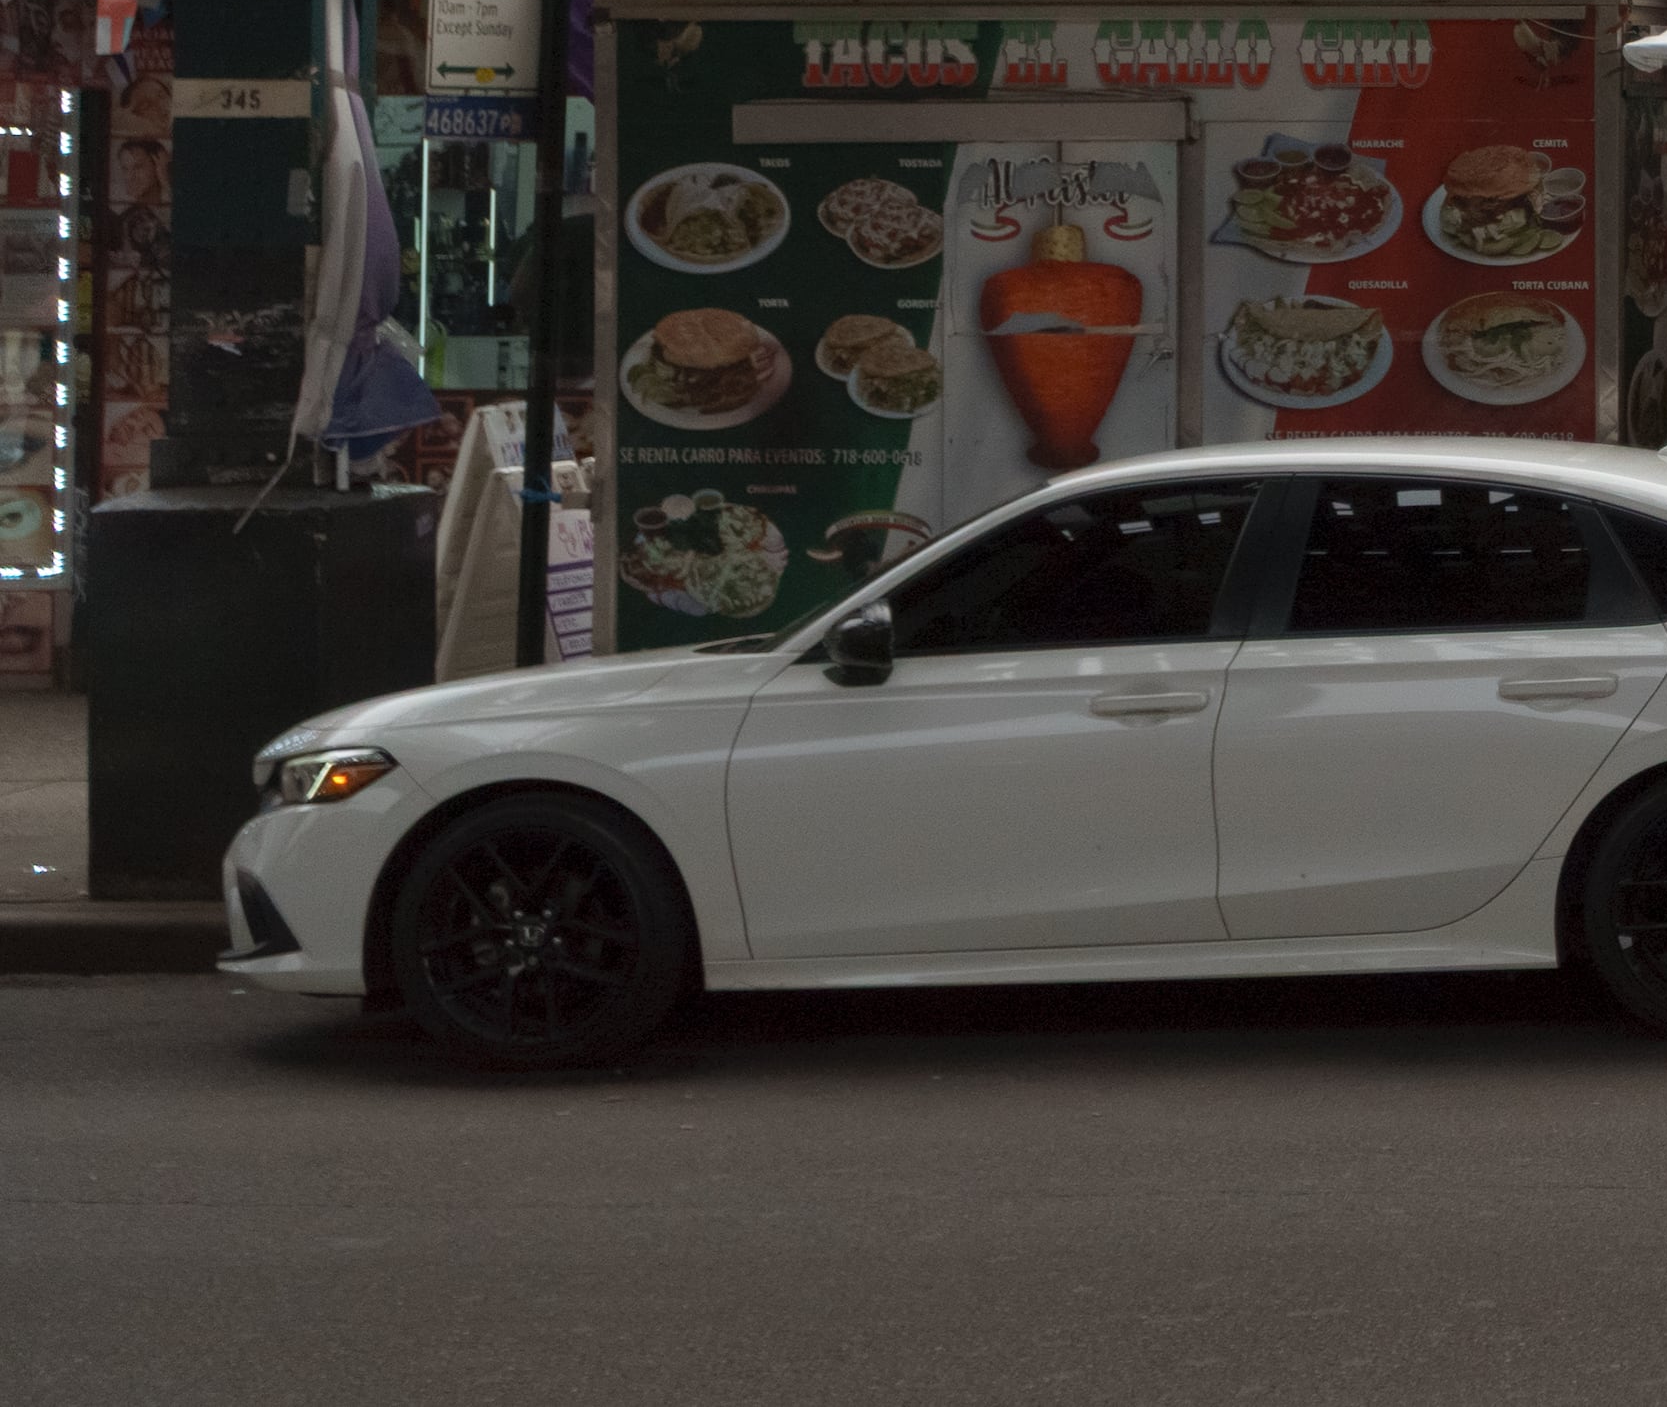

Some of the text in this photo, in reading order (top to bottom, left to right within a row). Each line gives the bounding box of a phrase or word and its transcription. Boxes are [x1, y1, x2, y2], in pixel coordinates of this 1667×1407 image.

[437, 0, 463, 18] 10am
[475, 2, 499, 21] 7pm
[436, 16, 514, 41] Except Sunday
[798, 19, 1435, 90] TACOS EL GALLO GIRO
[220, 89, 263, 111] 345
[426, 107, 499, 136] 468637
[1351, 138, 1405, 150] HUARACHE
[1531, 137, 1570, 150] CEMITA
[759, 157, 791, 168] TACOS
[898, 158, 943, 169] TOSTADA
[1347, 278, 1409, 291] QUESADILLA
[1511, 279, 1591, 292] TORTA CUBANA
[757, 297, 790, 309] TORTA
[619, 447, 635, 464] SE
[637, 448, 679, 465] RENTA
[681, 448, 725, 465] CARRO
[727, 448, 762, 465] PARA
[764, 448, 827, 465] EVENTOS:
